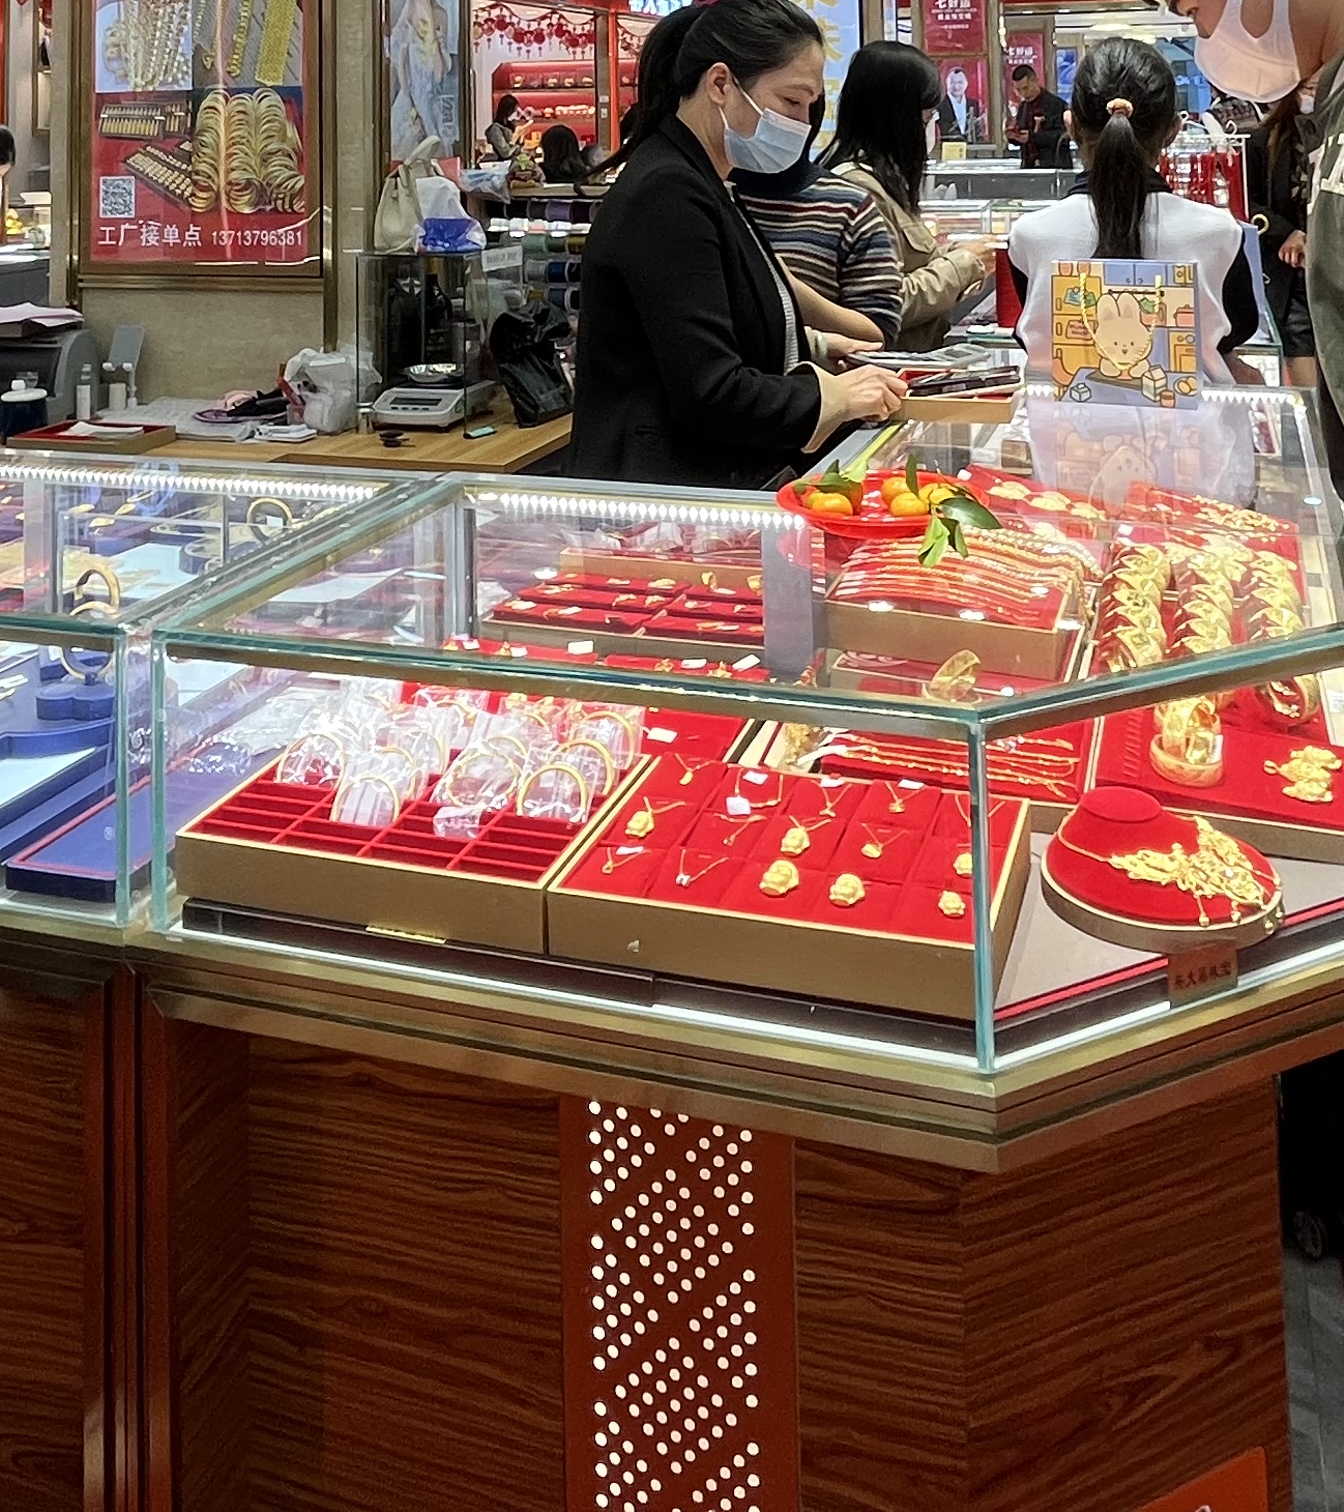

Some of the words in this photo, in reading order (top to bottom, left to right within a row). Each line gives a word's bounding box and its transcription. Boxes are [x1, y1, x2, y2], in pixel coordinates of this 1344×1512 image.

[98, 223, 202, 247] 工厂接单点
[212, 230, 302, 246] 13713796381
